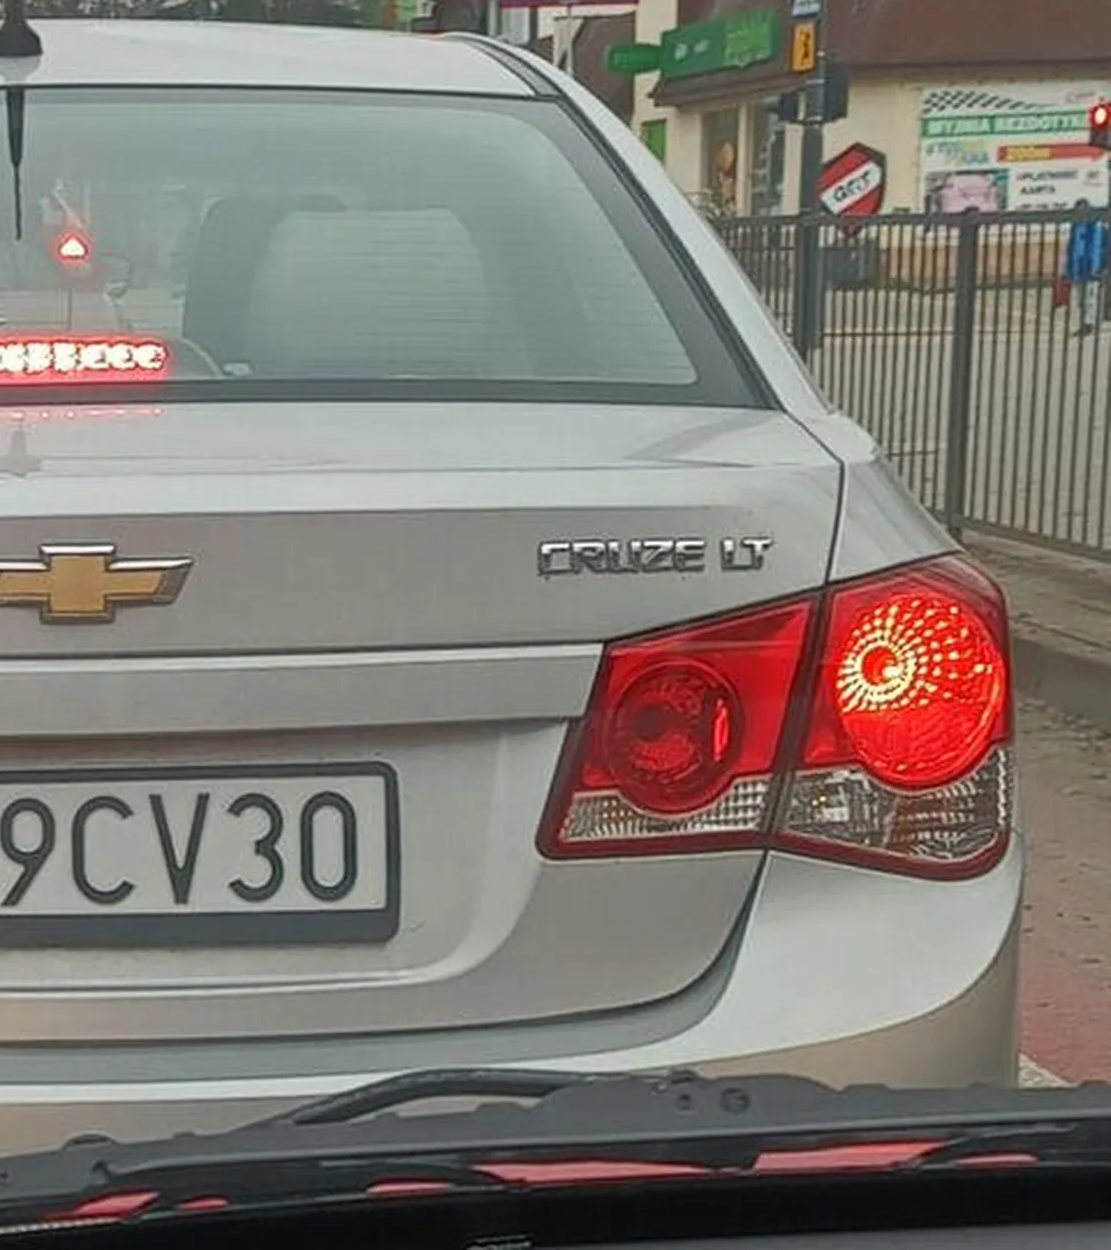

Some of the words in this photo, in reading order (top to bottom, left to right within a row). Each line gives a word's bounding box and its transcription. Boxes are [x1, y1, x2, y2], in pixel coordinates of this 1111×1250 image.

[538, 537, 706, 576] CRUZE
[720, 536, 775, 572] LT
[0, 790, 359, 908] 9CV30
